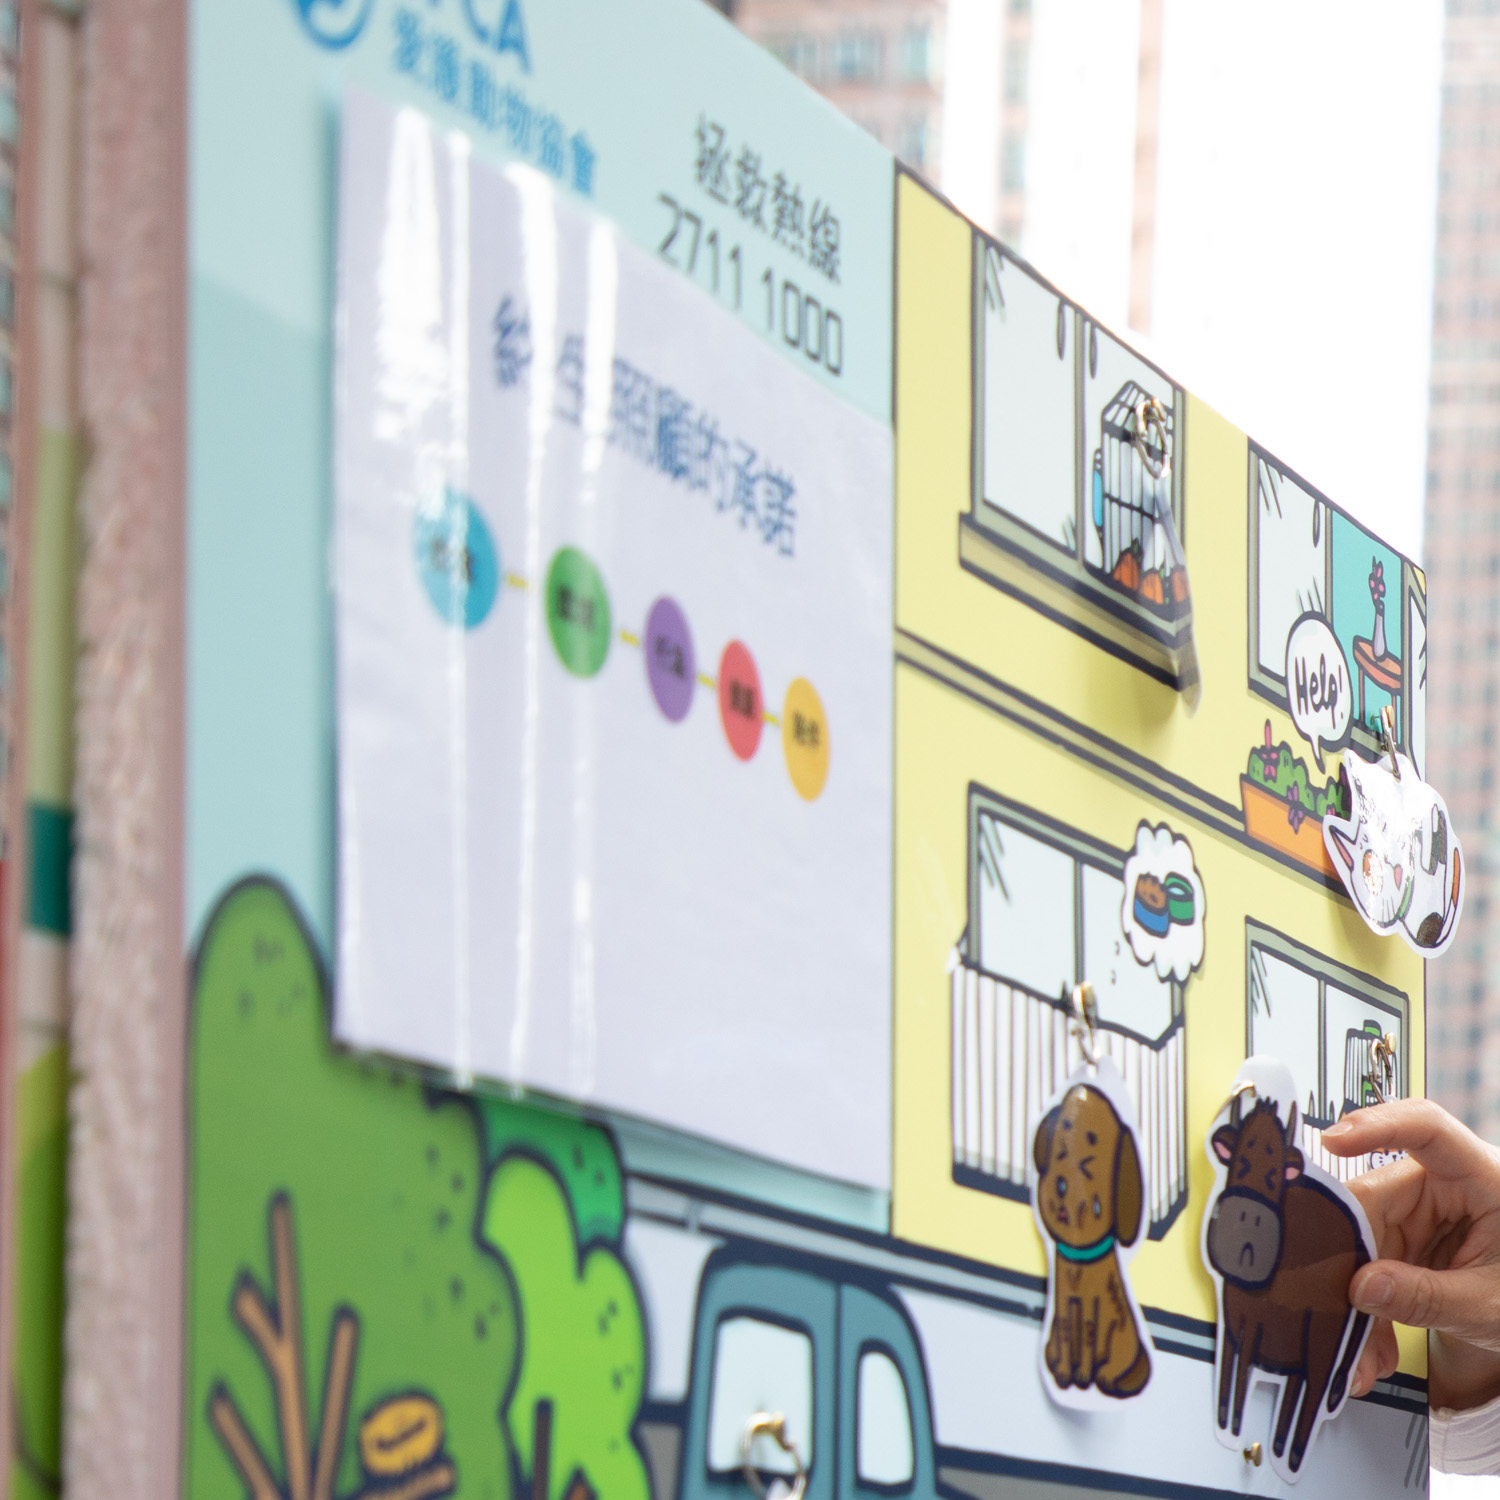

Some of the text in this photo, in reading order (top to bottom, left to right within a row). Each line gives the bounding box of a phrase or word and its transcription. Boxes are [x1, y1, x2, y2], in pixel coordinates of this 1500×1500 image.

[657, 192, 842, 377] 2711 1000
[694, 112, 841, 286] 拯救熱線
[1295, 653, 1343, 730] Help!
